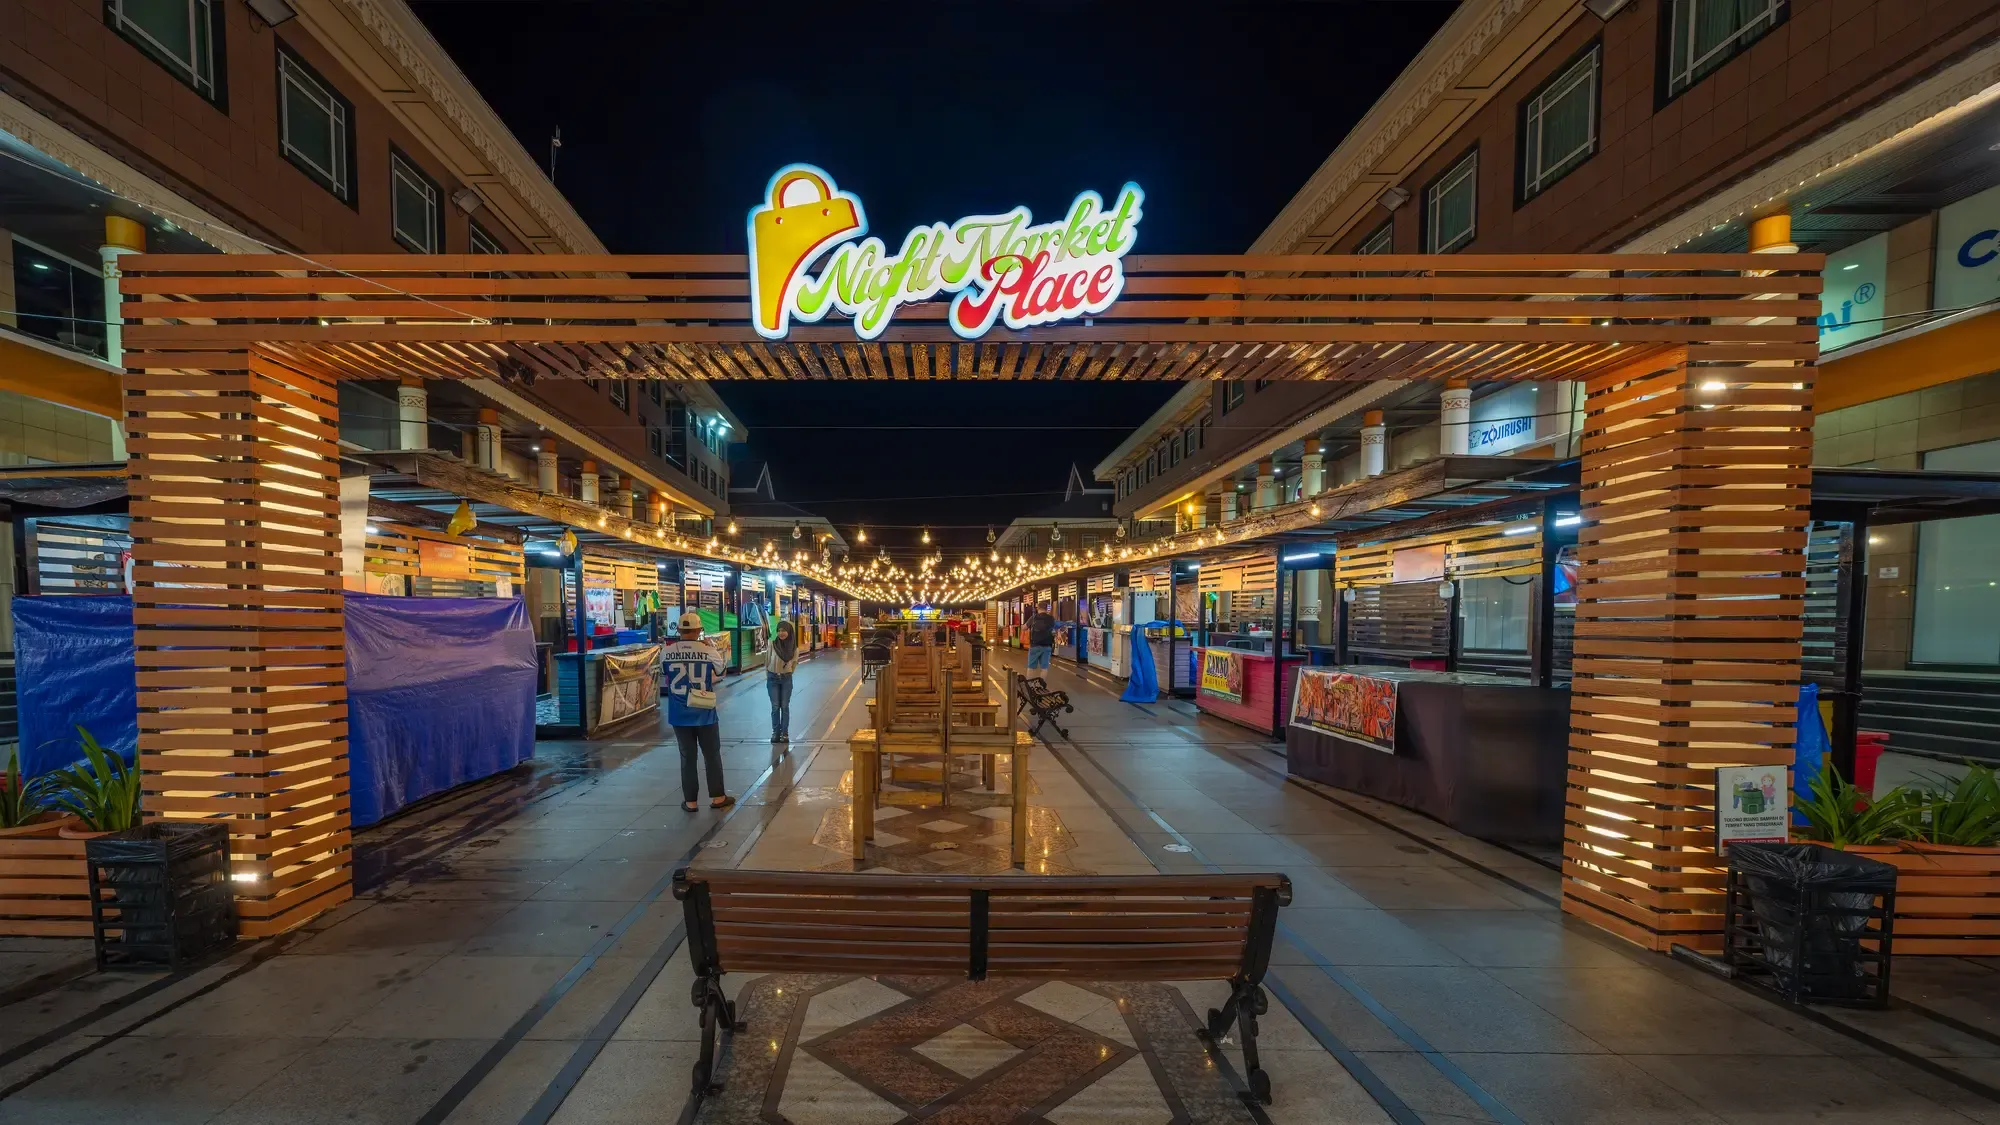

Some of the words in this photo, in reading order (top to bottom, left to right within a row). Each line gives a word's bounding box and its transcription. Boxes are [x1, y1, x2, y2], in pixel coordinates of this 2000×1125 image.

[797, 230, 945, 332] Night
[939, 190, 1136, 284] Market
[1957, 228, 2000, 268] C
[957, 250, 1114, 329] Place
[1482, 418, 1531, 445] ZOJIRUSHI
[666, 652, 708, 660] DOMINANT
[668, 662, 707, 694] 24
